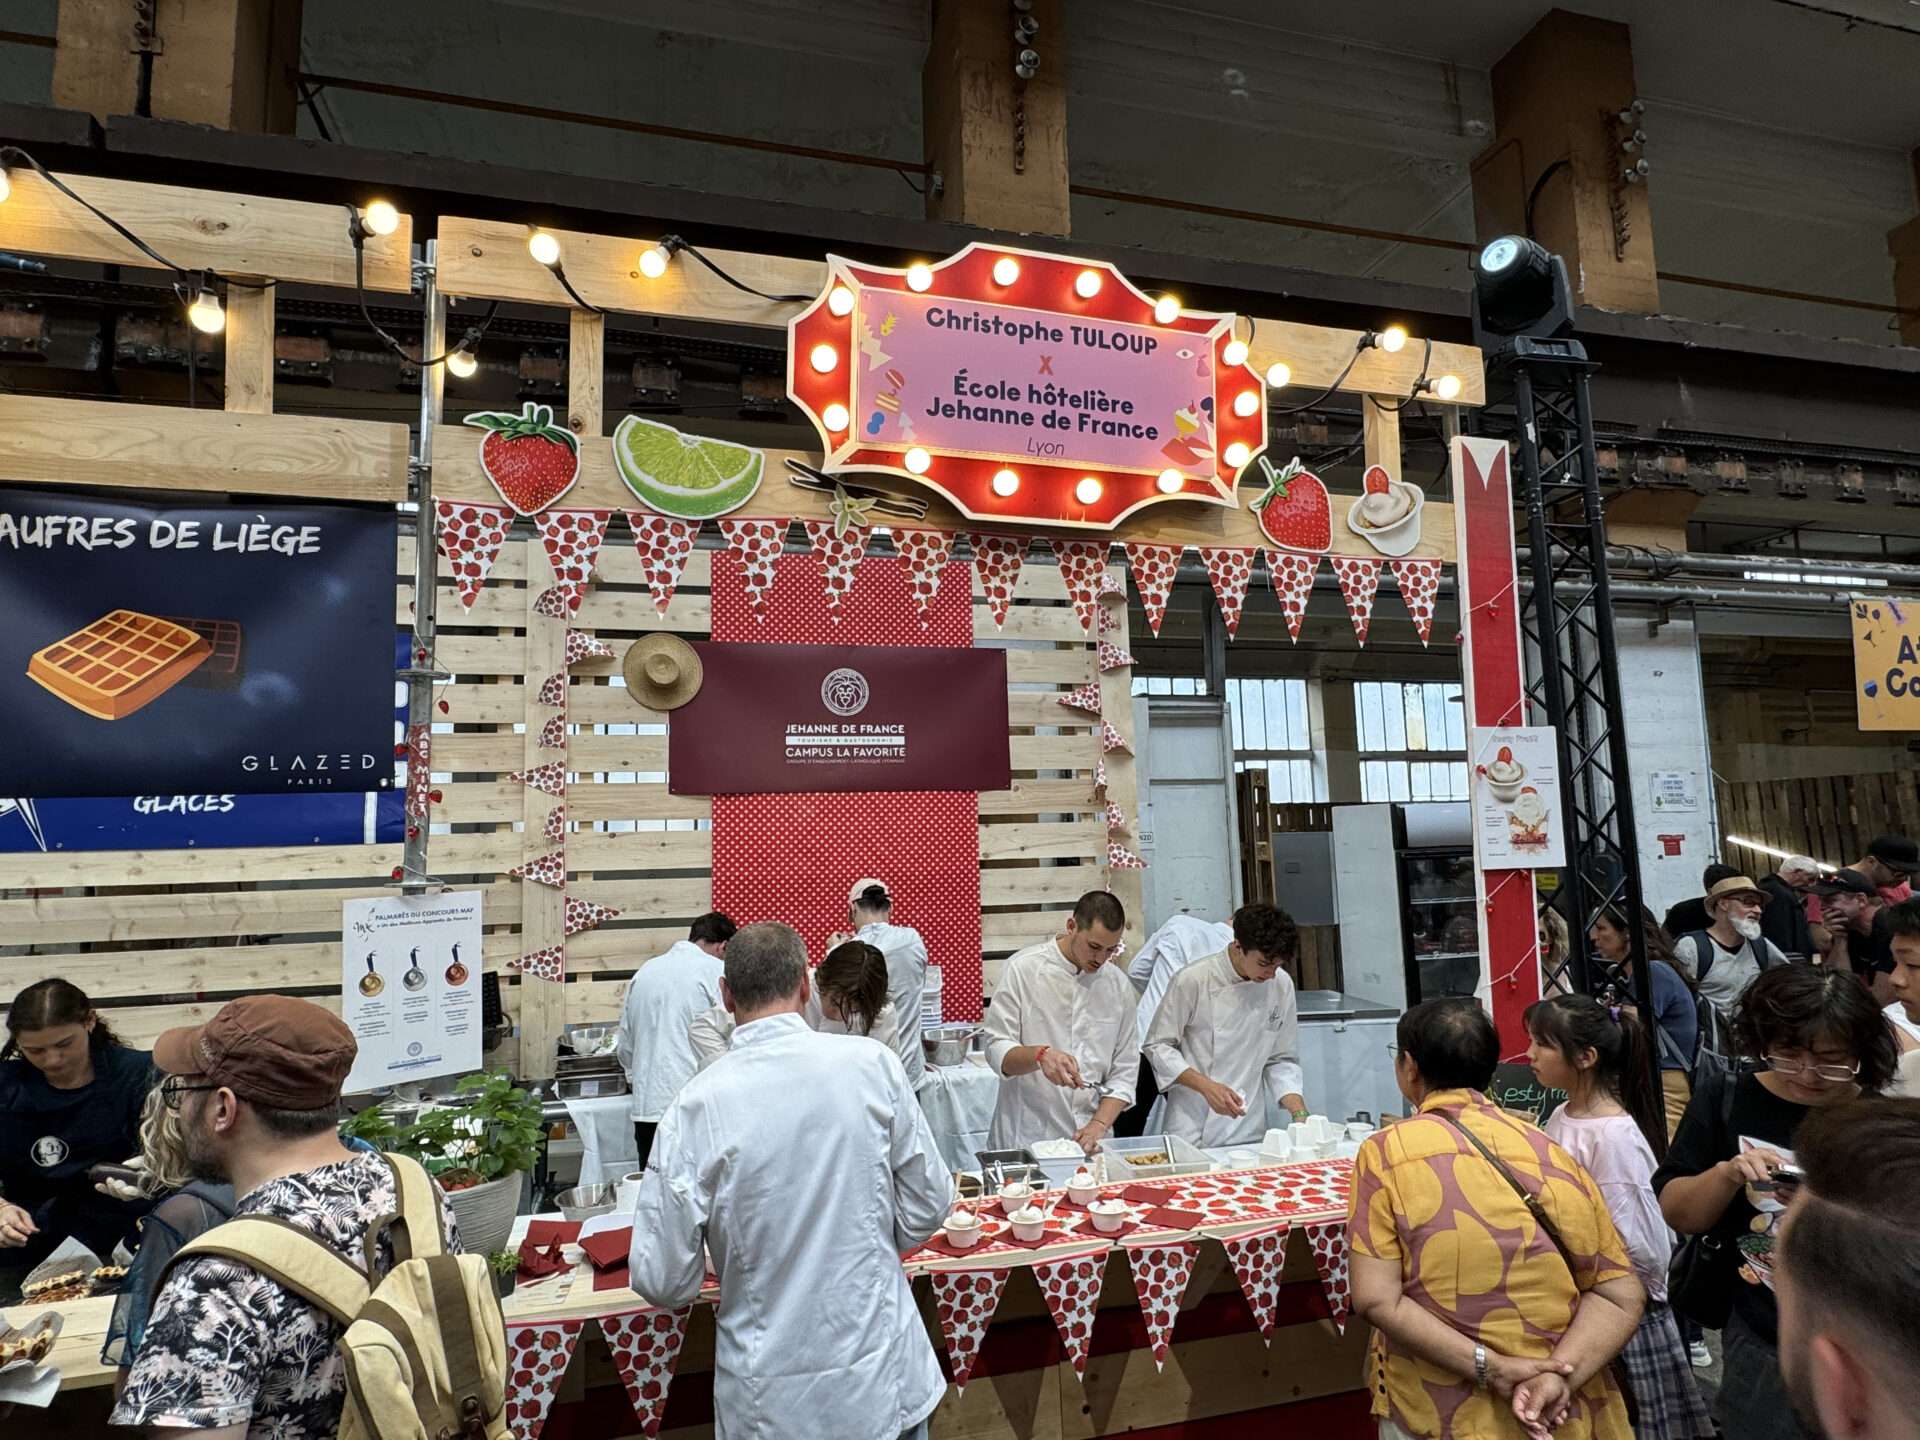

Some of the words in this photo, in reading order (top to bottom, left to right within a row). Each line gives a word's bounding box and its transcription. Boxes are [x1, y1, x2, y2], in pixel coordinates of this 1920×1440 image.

[926, 307, 1063, 344] Christophe
[1070, 326, 1158, 355] TULOUP
[954, 368, 1021, 401] École
[1028, 383, 1134, 415] hôtelière
[926, 397, 1034, 426] Jehanne
[1042, 410, 1071, 430] de
[1078, 414, 1159, 441] France
[1026, 437, 1065, 456] Lyon
[0, 513, 137, 551] AUFRES
[150, 520, 200, 550] DE
[212, 514, 321, 556] LIÈGE
[785, 724, 838, 734] JEHANNE
[842, 724, 857, 734] DE
[860, 724, 905, 734] FRANCE
[241, 754, 376, 771] GLAZED
[785, 747, 833, 757] CAMPUS
[836, 748, 851, 757] LA
[853, 747, 906, 757] FAVORITE
[133, 794, 236, 815] GLACES
